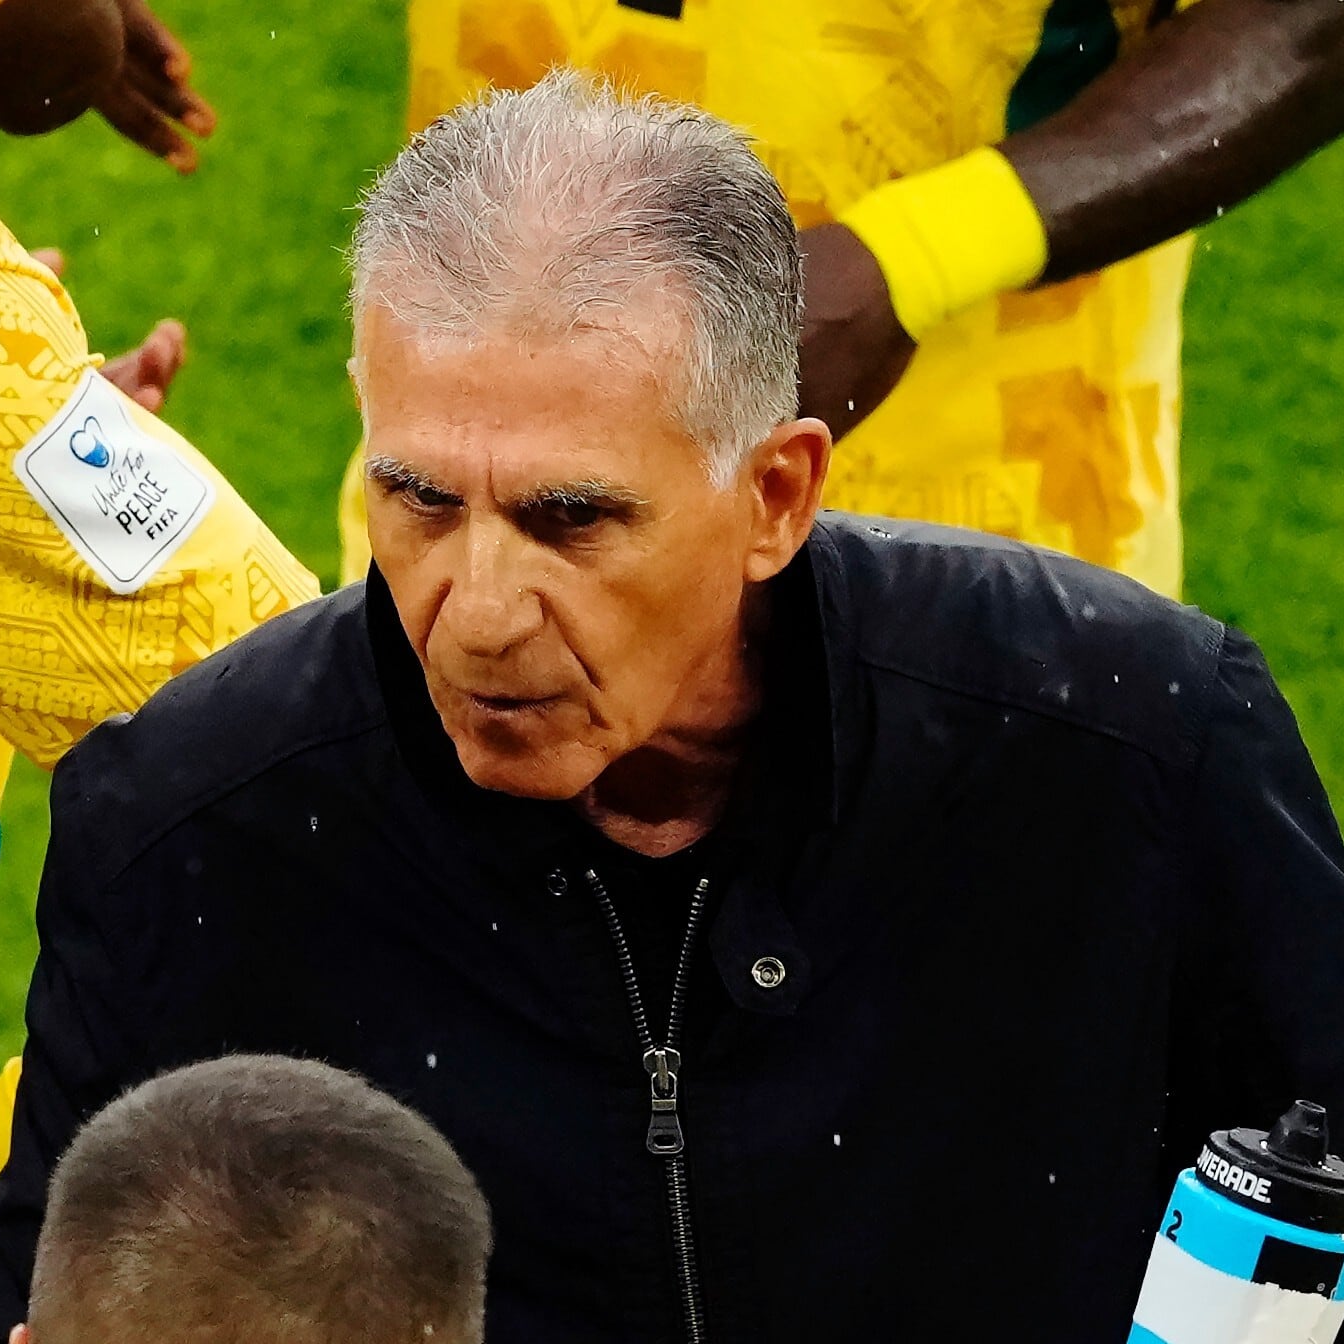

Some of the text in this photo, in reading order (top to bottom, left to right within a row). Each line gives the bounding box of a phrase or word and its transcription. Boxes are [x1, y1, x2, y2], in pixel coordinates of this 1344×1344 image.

[122, 448, 145, 480] For
[116, 471, 168, 535] PEACE
[146, 508, 178, 540] FIFA
[1197, 1144, 1271, 1203] WERADE
